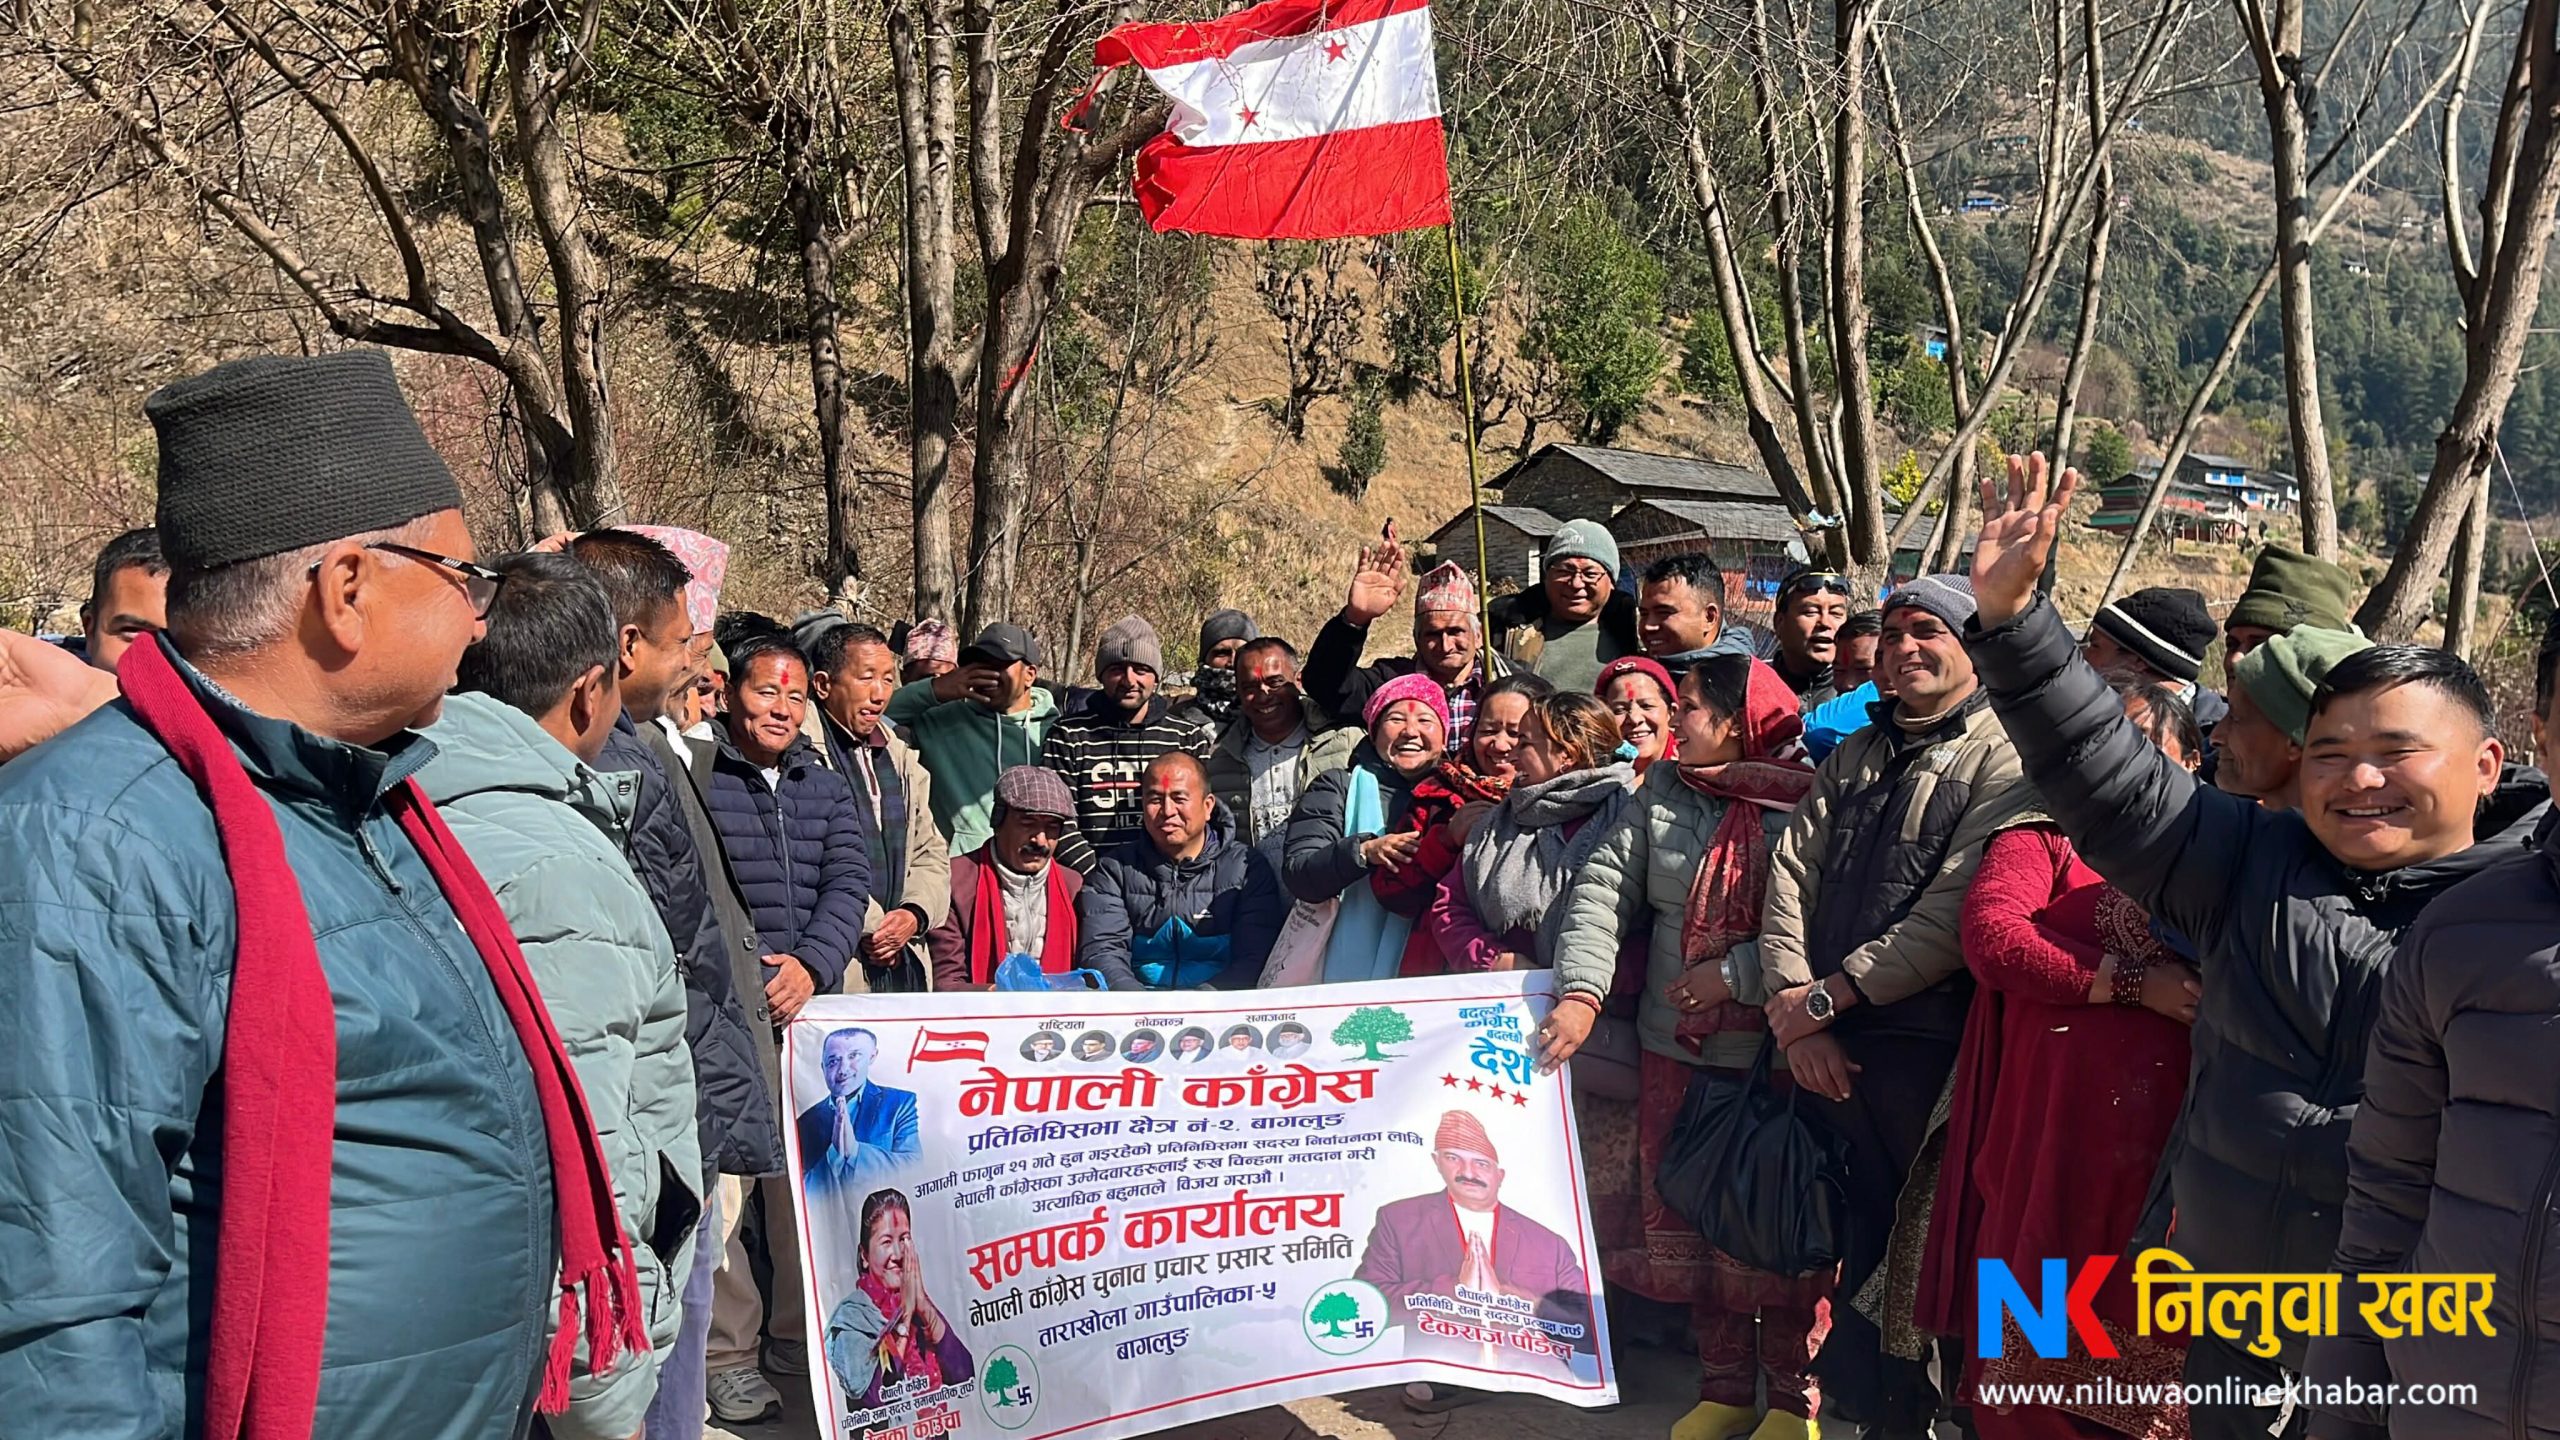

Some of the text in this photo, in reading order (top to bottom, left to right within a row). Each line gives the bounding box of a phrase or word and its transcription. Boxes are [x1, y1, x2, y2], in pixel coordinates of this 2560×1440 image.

[1245, 1013, 1296, 1023] समाजवाद
[1469, 1036, 1535, 1085] देश
[958, 1063, 1380, 1117] नेपाली काँग्रेस
[967, 1119, 1122, 1155] प्रतिनिधिसभा
[1129, 1116, 1179, 1134] क्षेत्र
[1250, 1113, 1346, 1130] बागलुङ
[914, 1171, 958, 1199] आगामी
[962, 1163, 1005, 1181] फागुन
[1008, 1159, 1027, 1172] २१
[1032, 1152, 1056, 1169] गते
[1089, 1142, 1151, 1161] गइरहेको
[1157, 1139, 1248, 1155] प्रतिनिधिसभा
[1253, 1137, 1300, 1149] सदस्य
[1387, 1131, 1424, 1146] लागि
[954, 1184, 996, 1209] नेपाली
[1228, 1153, 1283, 1167] चिन्हमा
[1288, 1150, 1342, 1163] मतदान
[1347, 1147, 1377, 1160] गरी
[1106, 1178, 1166, 1201] बहुमतले
[1176, 1173, 1218, 1191] विजय
[966, 1189, 1345, 1291] सम्पर्क कार्यालय
[969, 1233, 1354, 1330] नेपाली काँग्रेस चुनाव प्रचार प्रसार समिति
[1457, 1286, 1493, 1305] नेपाली
[1038, 1304, 1128, 1348] ताराखोला
[1407, 1295, 1454, 1312] प्रतिनिधि
[1458, 1303, 1481, 1317] सभा
[1484, 1309, 1520, 1324] सदस्य
[1116, 1327, 1190, 1361] बागलुङ
[1419, 1312, 1574, 1360] टेकराज पौडेल
